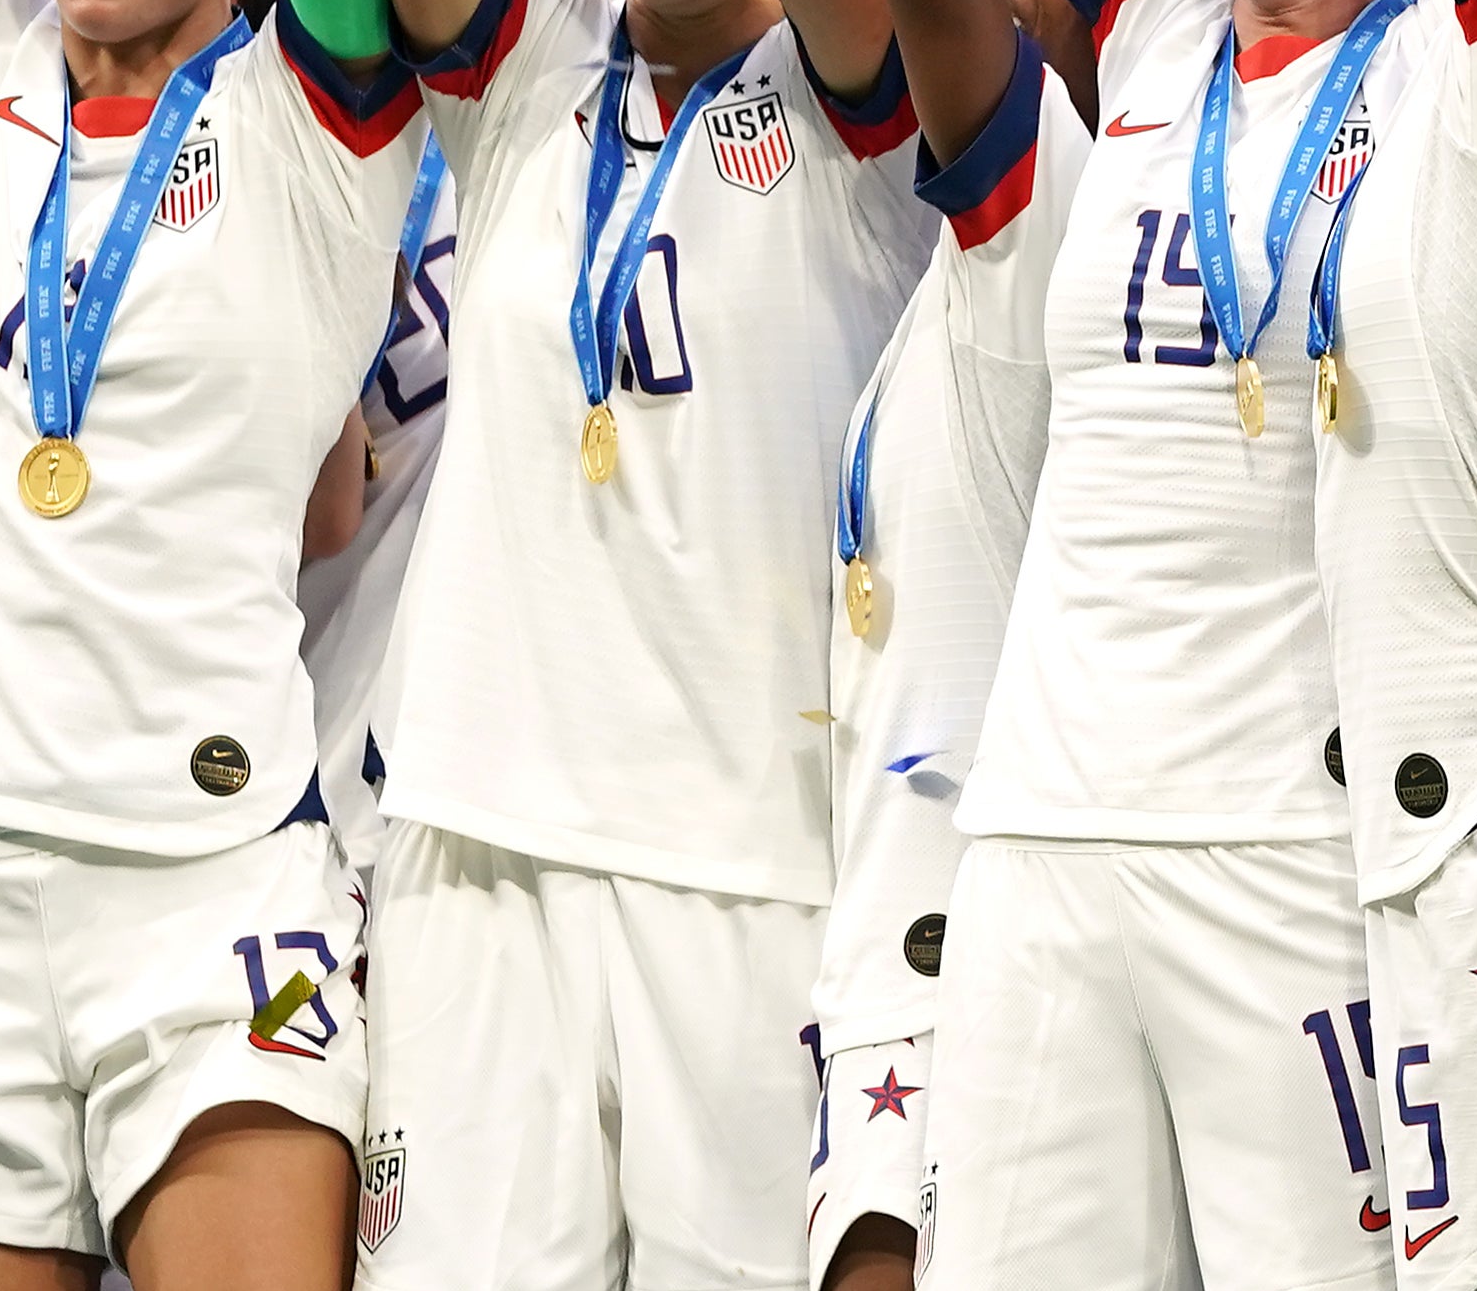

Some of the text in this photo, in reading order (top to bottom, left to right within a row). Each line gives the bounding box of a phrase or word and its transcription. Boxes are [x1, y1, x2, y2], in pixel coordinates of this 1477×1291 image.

[1332, 65, 1352, 93] FIFA
[160, 107, 181, 139] FIFA
[712, 102, 779, 144] USA
[1314, 106, 1333, 134] FIFA
[1327, 127, 1370, 155] SA
[140, 154, 161, 185] FIFA
[173, 146, 211, 185] SA
[1296, 147, 1315, 176] FIFA
[121, 199, 142, 233] FIFA
[1279, 189, 1298, 220] FIFA
[1204, 208, 1218, 239] FIFA
[40, 239, 52, 269] FIFA
[102, 247, 123, 281] FIFA
[1210, 255, 1227, 286] FIFA
[39, 284, 50, 319] FIFA
[84, 296, 103, 333] FIFA
[620, 232, 694, 395] 0
[40, 337, 52, 373] FIFA
[71, 349, 87, 386] FIFA
[44, 389, 56, 424] FIFA
[1395, 1043, 1450, 1210] 5
[364, 1156, 400, 1197] USA
